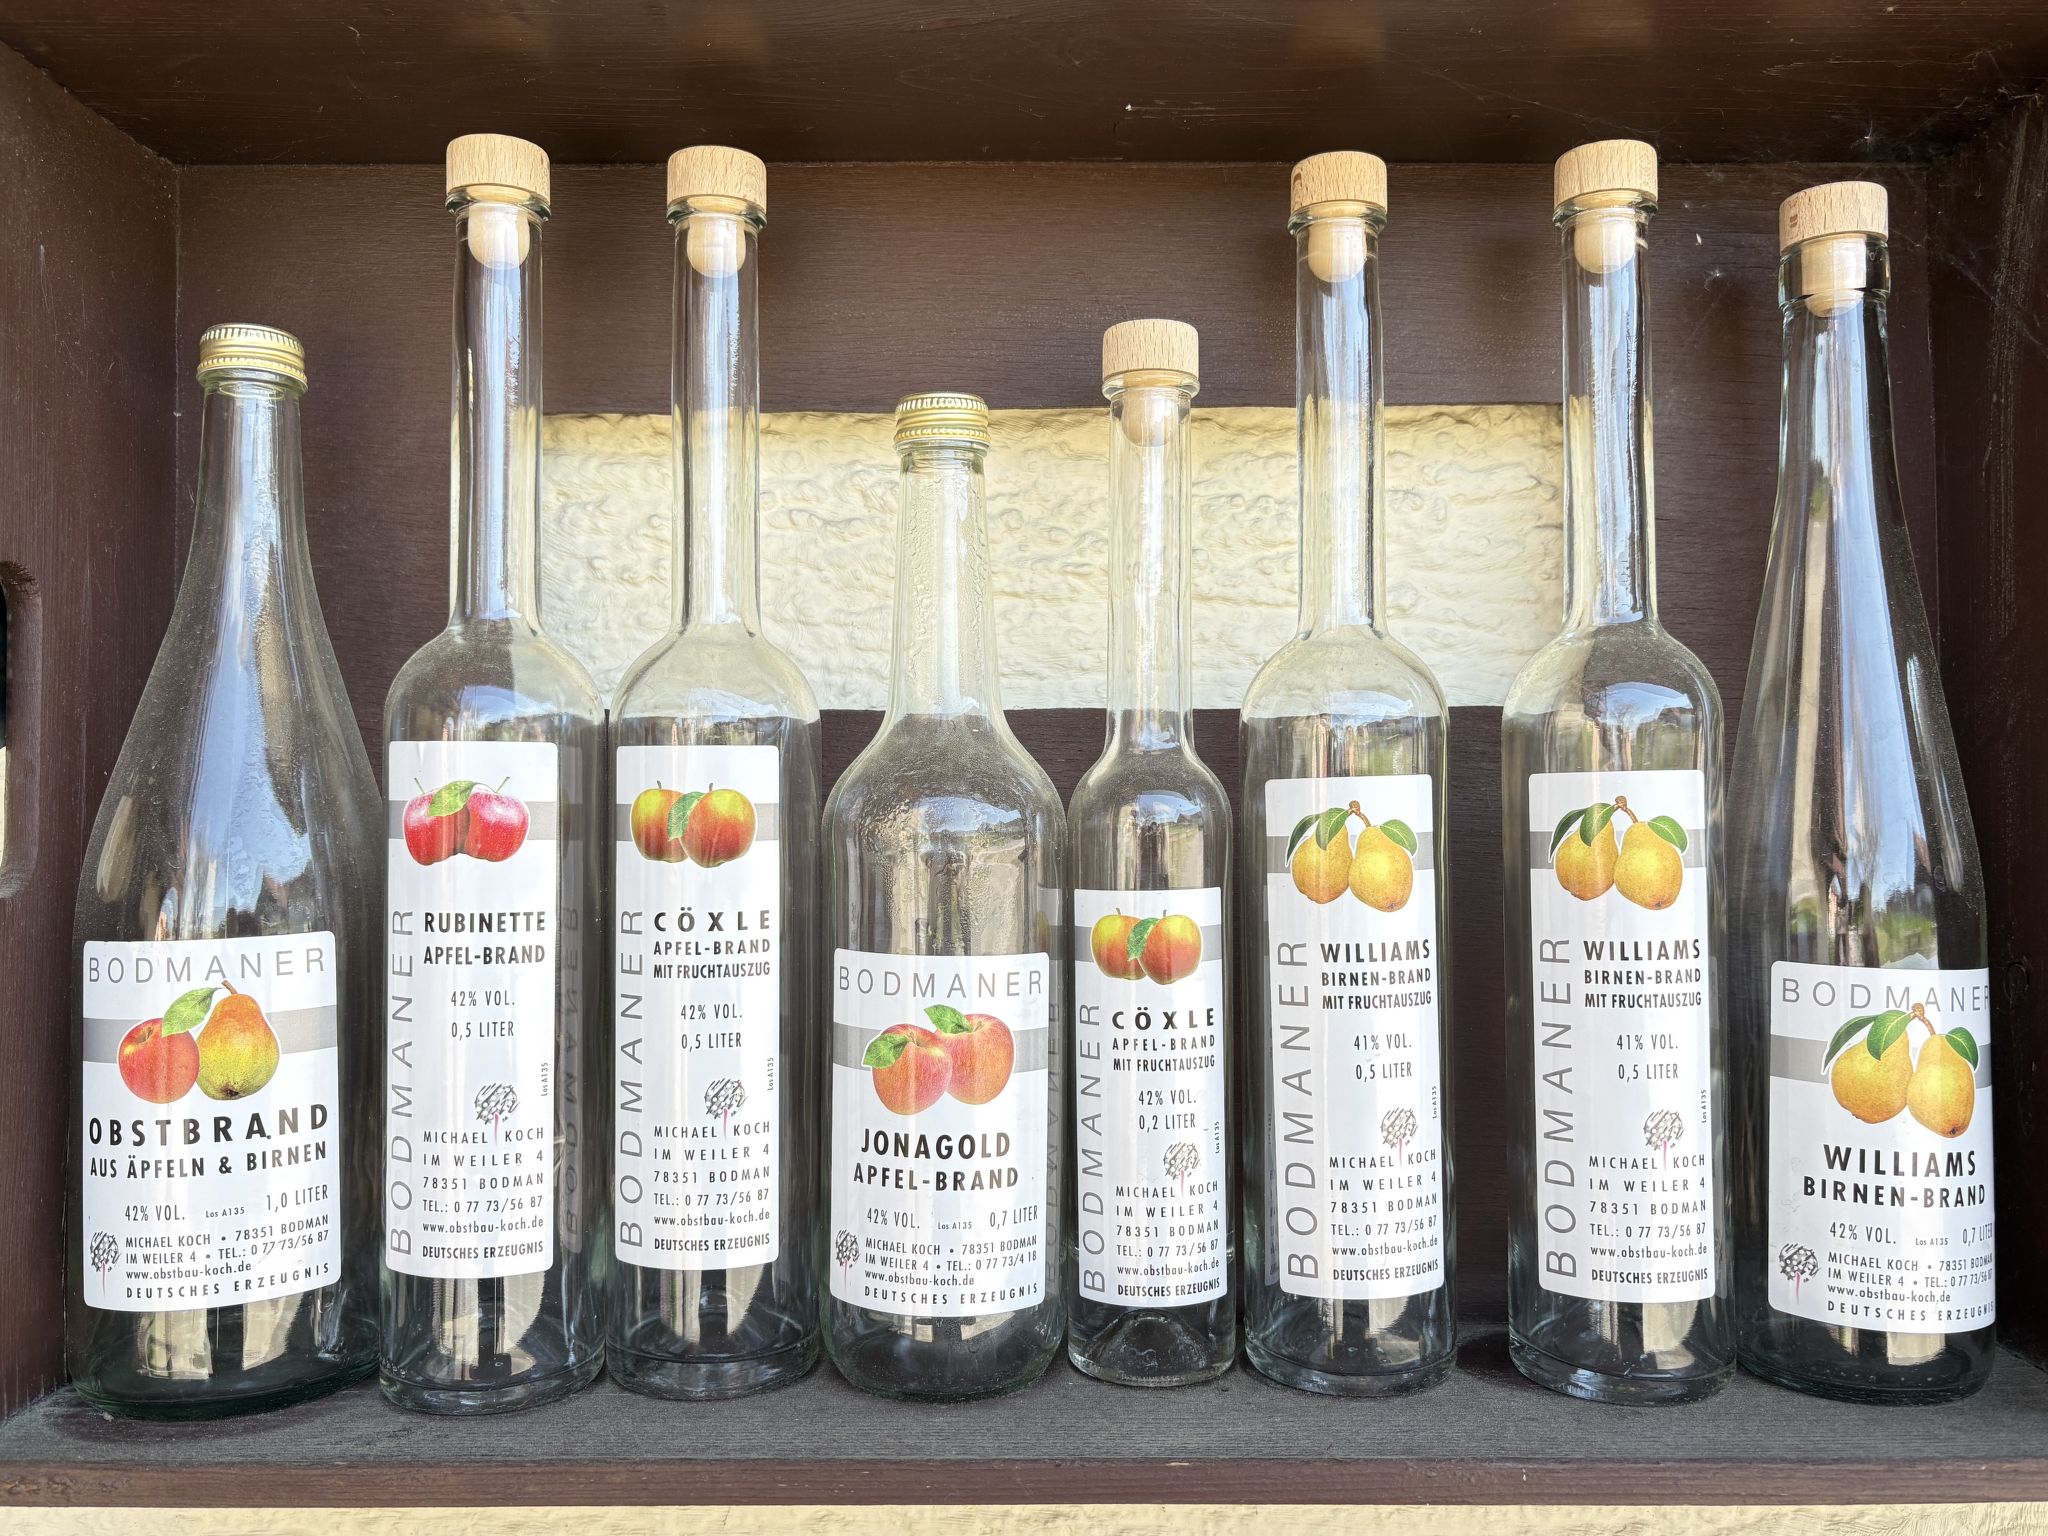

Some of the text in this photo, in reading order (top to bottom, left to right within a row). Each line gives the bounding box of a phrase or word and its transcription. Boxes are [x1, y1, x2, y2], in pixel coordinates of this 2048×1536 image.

[424, 910, 546, 933] RUBINETTE
[654, 906, 770, 932] CÖXLE
[424, 945, 546, 965] APFEL-BRAND
[654, 938, 770, 956] APFEL-BRAND
[1320, 939, 1430, 963] WILLIAMS
[1584, 938, 1700, 961] WILLIAMS
[89, 947, 325, 984] BODMANER
[654, 962, 770, 979] MIT FRUCHTAUSZUG
[839, 966, 1042, 998] BODMANER
[1322, 968, 1431, 987] BIRNEN-BRAND
[1584, 968, 1701, 985] BIRNEN-BRAND
[450, 990, 515, 1007] 42% VOL.
[1322, 990, 1432, 1010] MIT FRUCHTAUSZUG
[1584, 992, 1702, 1008] MIT FRUCHTAUSZUG
[680, 1002, 742, 1020] 42% VOL.
[1112, 1006, 1214, 1030] CÖXLE
[451, 1020, 514, 1041] 0,5 LITER
[681, 1032, 742, 1053] 0,5 LITER
[1112, 1034, 1215, 1052] APFEL-BRAND
[1354, 1033, 1412, 1051] 41% VOL.
[1616, 1034, 1678, 1050] 41% VOL.
[1114, 1054, 1215, 1072] MIT FRUCHTAUSZUG
[1356, 1062, 1412, 1083] 0,5 LITER
[1618, 1064, 1678, 1082] 0,5 LITER
[390, 909, 413, 1256] BODMANER
[541, 1062, 549, 1097] Los A135
[620, 910, 643, 1248] BODMANER
[1138, 1089, 1196, 1106] 42% VOL.
[1540, 938, 1576, 1278] BODMANER
[1278, 942, 1318, 1279] BODMANER
[89, 1103, 328, 1147] OBSTBRAND
[654, 1121, 770, 1138] MICHAEL KOCH
[1139, 1113, 1196, 1133] 0,2 LITER
[424, 1127, 544, 1144] MICHAEL KOCH
[861, 1128, 1010, 1160] JONAGOLD
[424, 1150, 544, 1167] IM WEILER 4
[1080, 1004, 1106, 1293] BODMANER
[90, 1140, 327, 1179] AUS ÄPFELN & BIRNEN
[1589, 1154, 1705, 1170] MICHAEL KOCH
[1823, 1144, 1976, 1178] WILLIAMS
[423, 1172, 544, 1190] 78351 BODMAN
[854, 1162, 1018, 1192] APFEL-BRAND
[1116, 1180, 1218, 1198] MICHAEL KOCH
[1804, 1176, 1985, 1208] BIRNEN-BRAND
[125, 1184, 328, 1222] 42% VOL. Los A135 1,0 LITER
[422, 1195, 544, 1214] TEL.: 0 77 73/56 87
[1330, 1192, 1437, 1214] 78351 BODMAN
[422, 1215, 544, 1233] www.obstbau-koch.de
[654, 1208, 770, 1226] www.obstbau-koch.de
[867, 1204, 1038, 1230] 42% VOL. Los A135 0,7 LITER
[126, 1214, 329, 1248] MICHAEL KOCH 78351 BODMAN
[1830, 1221, 1858, 1241] 42%
[1866, 1226, 1896, 1244] VOL.
[1916, 1238, 1927, 1246] Los
[1929, 1237, 1949, 1246] A135
[1962, 1228, 1976, 1247] 0,7
[126, 1230, 329, 1264] IM WEILER 4 TEL.: 0 77 73/56 87
[422, 1241, 544, 1260] DEUTSCHES ERZEUGNIS
[654, 1233, 770, 1252] DEUTSCHES ERZEUGNIS
[866, 1234, 1037, 1256] MICHAEL KOCH 78351 BODMAN
[1332, 1235, 1438, 1256] www.obstbau-koch.de
[1590, 1242, 1708, 1259] www.obstbau-koch.de
[126, 1262, 252, 1280] www.obstbau-koch.de
[865, 1251, 1037, 1272] IM WEILER 4 TEL.: 0 77 73/4 18
[1118, 1257, 1220, 1276] www.obstbau-koch.de
[1333, 1258, 1439, 1281] DEUTSCHES ERZEUGNIS
[1828, 1251, 1882, 1270] MICHAEL
[1887, 1258, 1918, 1272] KOCH
[1939, 1258, 1967, 1272] 78351
[126, 1262, 329, 1298] DEUTSCHES ERZEUGNIS
[865, 1269, 974, 1286] www.obstbau-koch.de
[1592, 1268, 1708, 1284] DEUTSCHES ERZEUGNIS
[1828, 1268, 1904, 1287] IM WEILER 4
[865, 1282, 1038, 1305] DEUTSCHES ERZEUGNIS
[1828, 1284, 1951, 1302] www.obstbau-koch.de
[1828, 1300, 1926, 1322] DEUTSCHES
